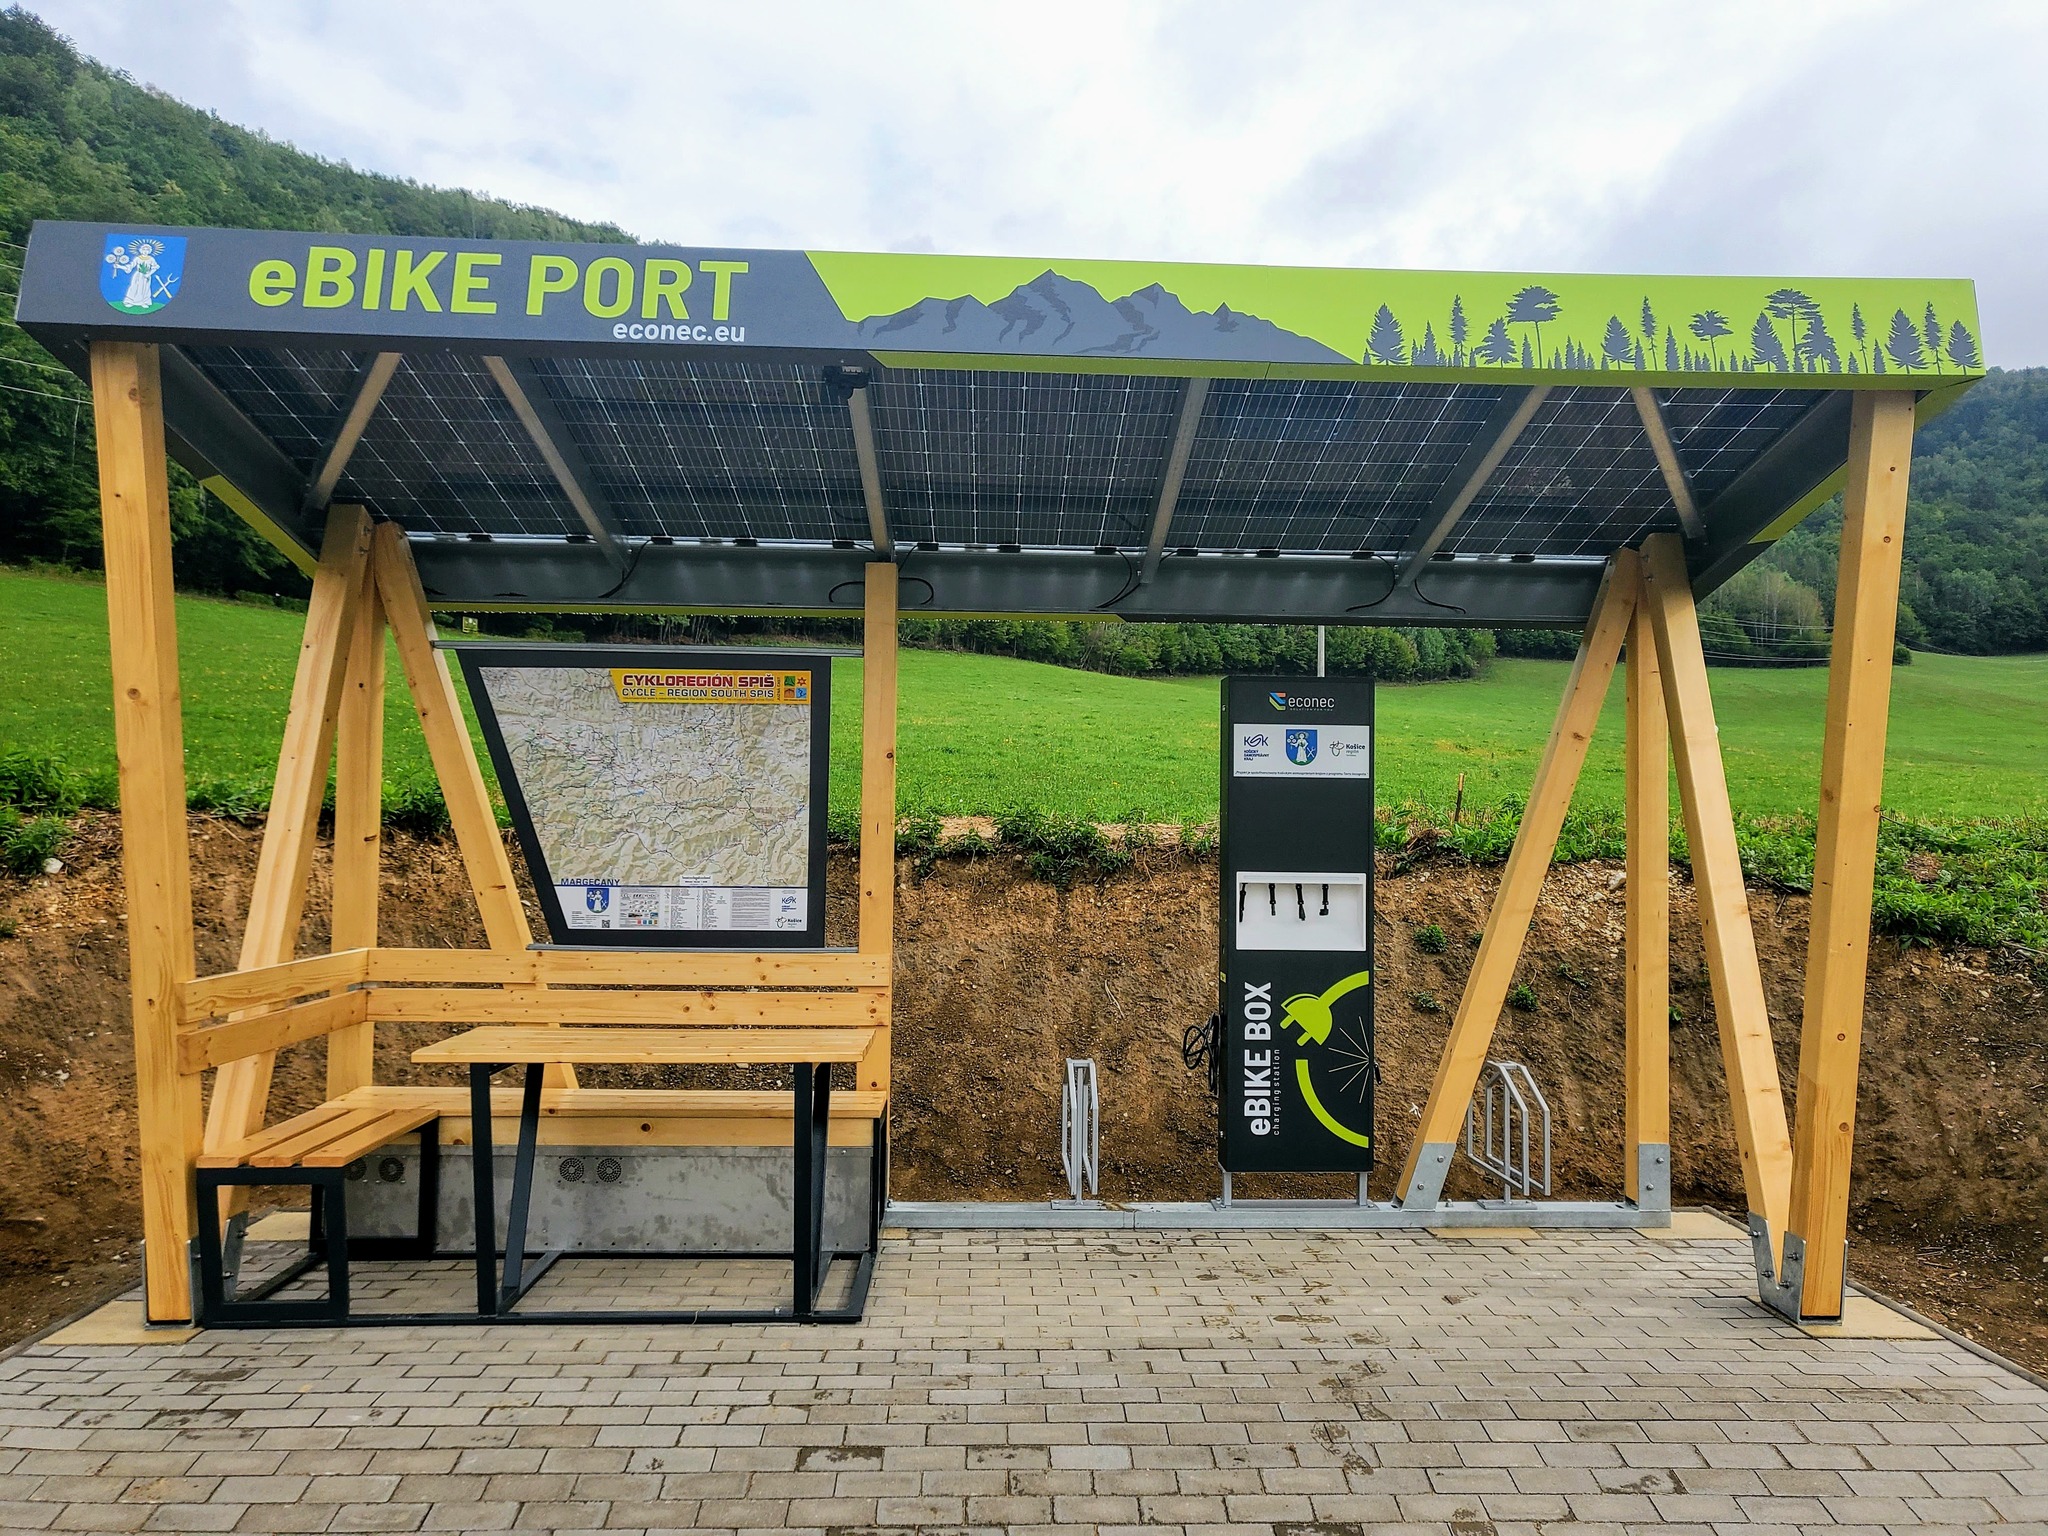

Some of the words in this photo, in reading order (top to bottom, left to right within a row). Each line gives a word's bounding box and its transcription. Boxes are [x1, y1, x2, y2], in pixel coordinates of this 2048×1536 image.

[249, 246, 502, 315] eBIKE
[526, 254, 749, 322] PORT
[612, 322, 746, 343] econec.eu
[622, 688, 656, 697] CYCLE
[667, 689, 707, 697] REGION
[710, 689, 747, 697] SOUTH
[749, 689, 774, 698] SPIS
[623, 673, 733, 687] CYKLOREGIÓN
[738, 674, 775, 687] SPIŠ
[1288, 697, 1335, 708] econec
[560, 878, 620, 886] MARGECANY
[1244, 981, 1272, 1041] BOX
[1272, 1049, 1280, 1087] station
[1244, 1049, 1271, 1136] eBIKE
[1272, 1090, 1282, 1136] charging
